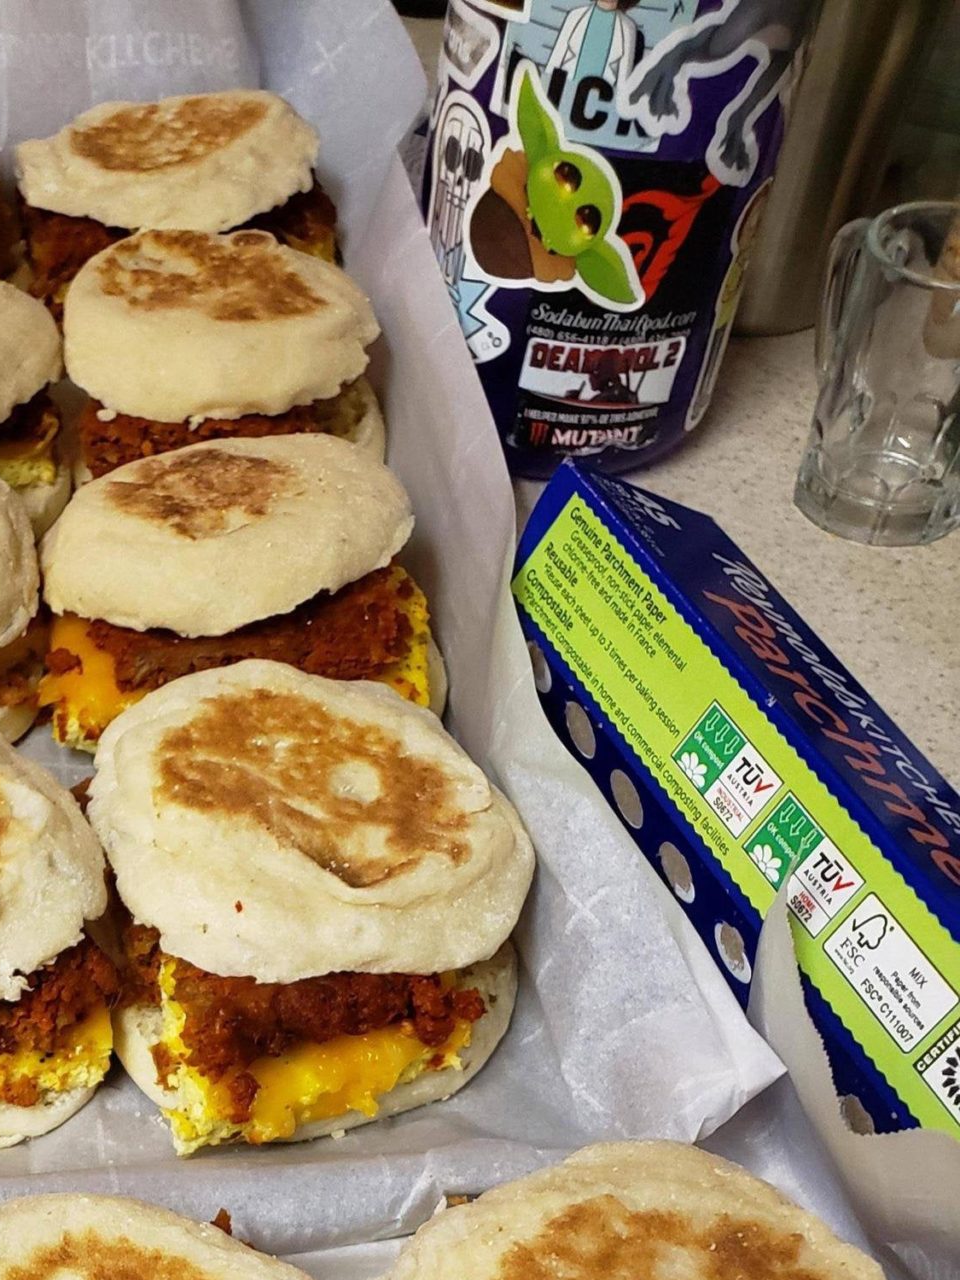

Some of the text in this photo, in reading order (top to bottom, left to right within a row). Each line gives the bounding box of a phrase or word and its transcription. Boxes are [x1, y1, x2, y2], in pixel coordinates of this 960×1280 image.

[529, 340, 681, 374] DEAOL 2
[544, 542, 578, 587] Reusable
[570, 507, 603, 549] Genuine
[601, 543, 645, 599] Parchment
[642, 593, 668, 625] Paper
[526, 568, 574, 631] Compostable
[563, 543, 657, 658] chlorine-free and made in France
[570, 531, 607, 578] Greaseproof,
[606, 575, 636, 611] non-stick
[633, 609, 654, 636] paper,
[652, 632, 688, 672] elemental
[712, 553, 867, 710] Reynolds
[561, 588, 577, 607] each
[574, 603, 591, 627] sheet
[589, 625, 600, 637] up
[597, 633, 607, 646] to
[603, 641, 611, 651] 3
[609, 648, 628, 673] times
[623, 670, 639, 684] per
[635, 682, 658, 711] baking
[655, 706, 681, 738] session
[555, 631, 593, 677] compostable
[590, 674, 599, 687] in
[596, 683, 616, 710] home
[614, 709, 630, 726] and
[626, 723, 666, 773] commercial
[663, 770, 702, 822] composting
[699, 816, 730, 856] facilities
[693, 731, 725, 770] OK compost
[716, 786, 744, 822] INDUSTRIAL
[727, 774, 754, 807] AUSTRIA
[767, 821, 797, 861] OK compo
[798, 891, 817, 912] HOME
[803, 869, 833, 906] AUSTRIA
[840, 937, 866, 968] FSC
[873, 965, 925, 1031] responsible sources
[890, 971, 922, 1009] Paper from
[909, 967, 929, 990] MIX
[879, 1002, 915, 1044] C111007
